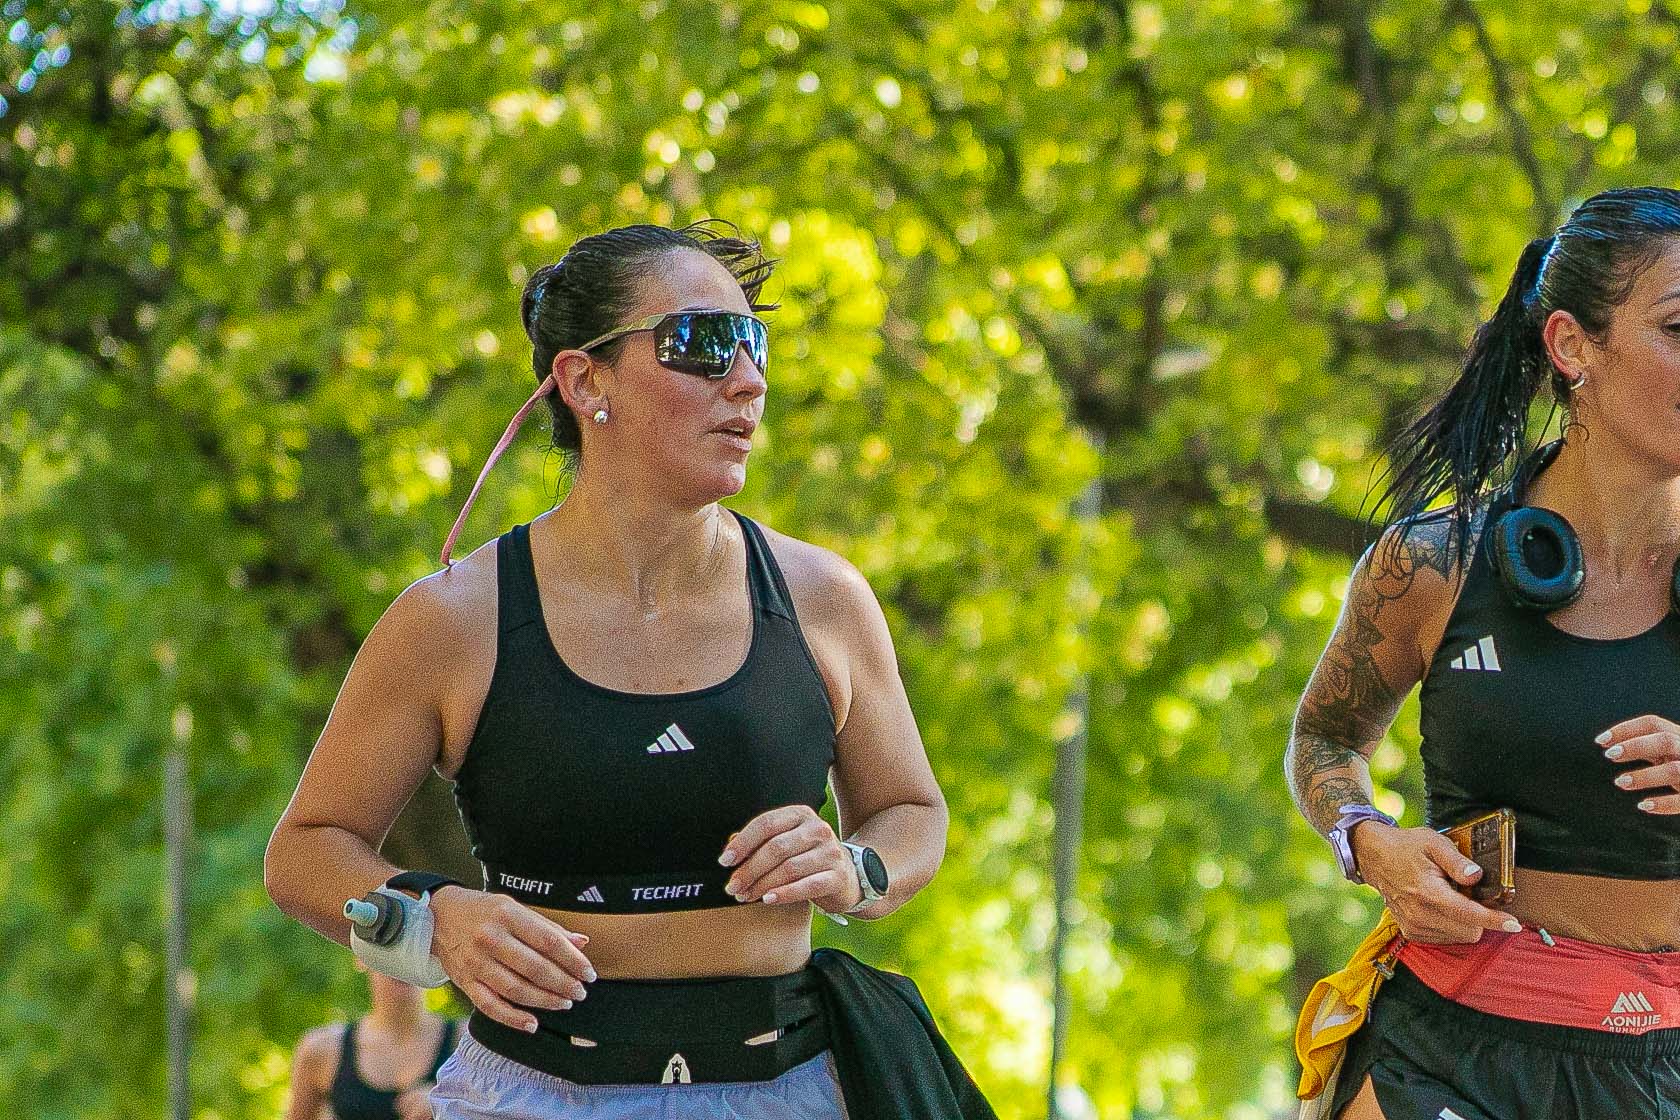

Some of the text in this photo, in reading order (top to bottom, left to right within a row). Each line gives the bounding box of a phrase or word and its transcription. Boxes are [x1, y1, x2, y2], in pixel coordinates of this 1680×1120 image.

[500, 873, 703, 901] TECHFIT TECHFIT
[1601, 1014, 1661, 1027] AONIJIE
